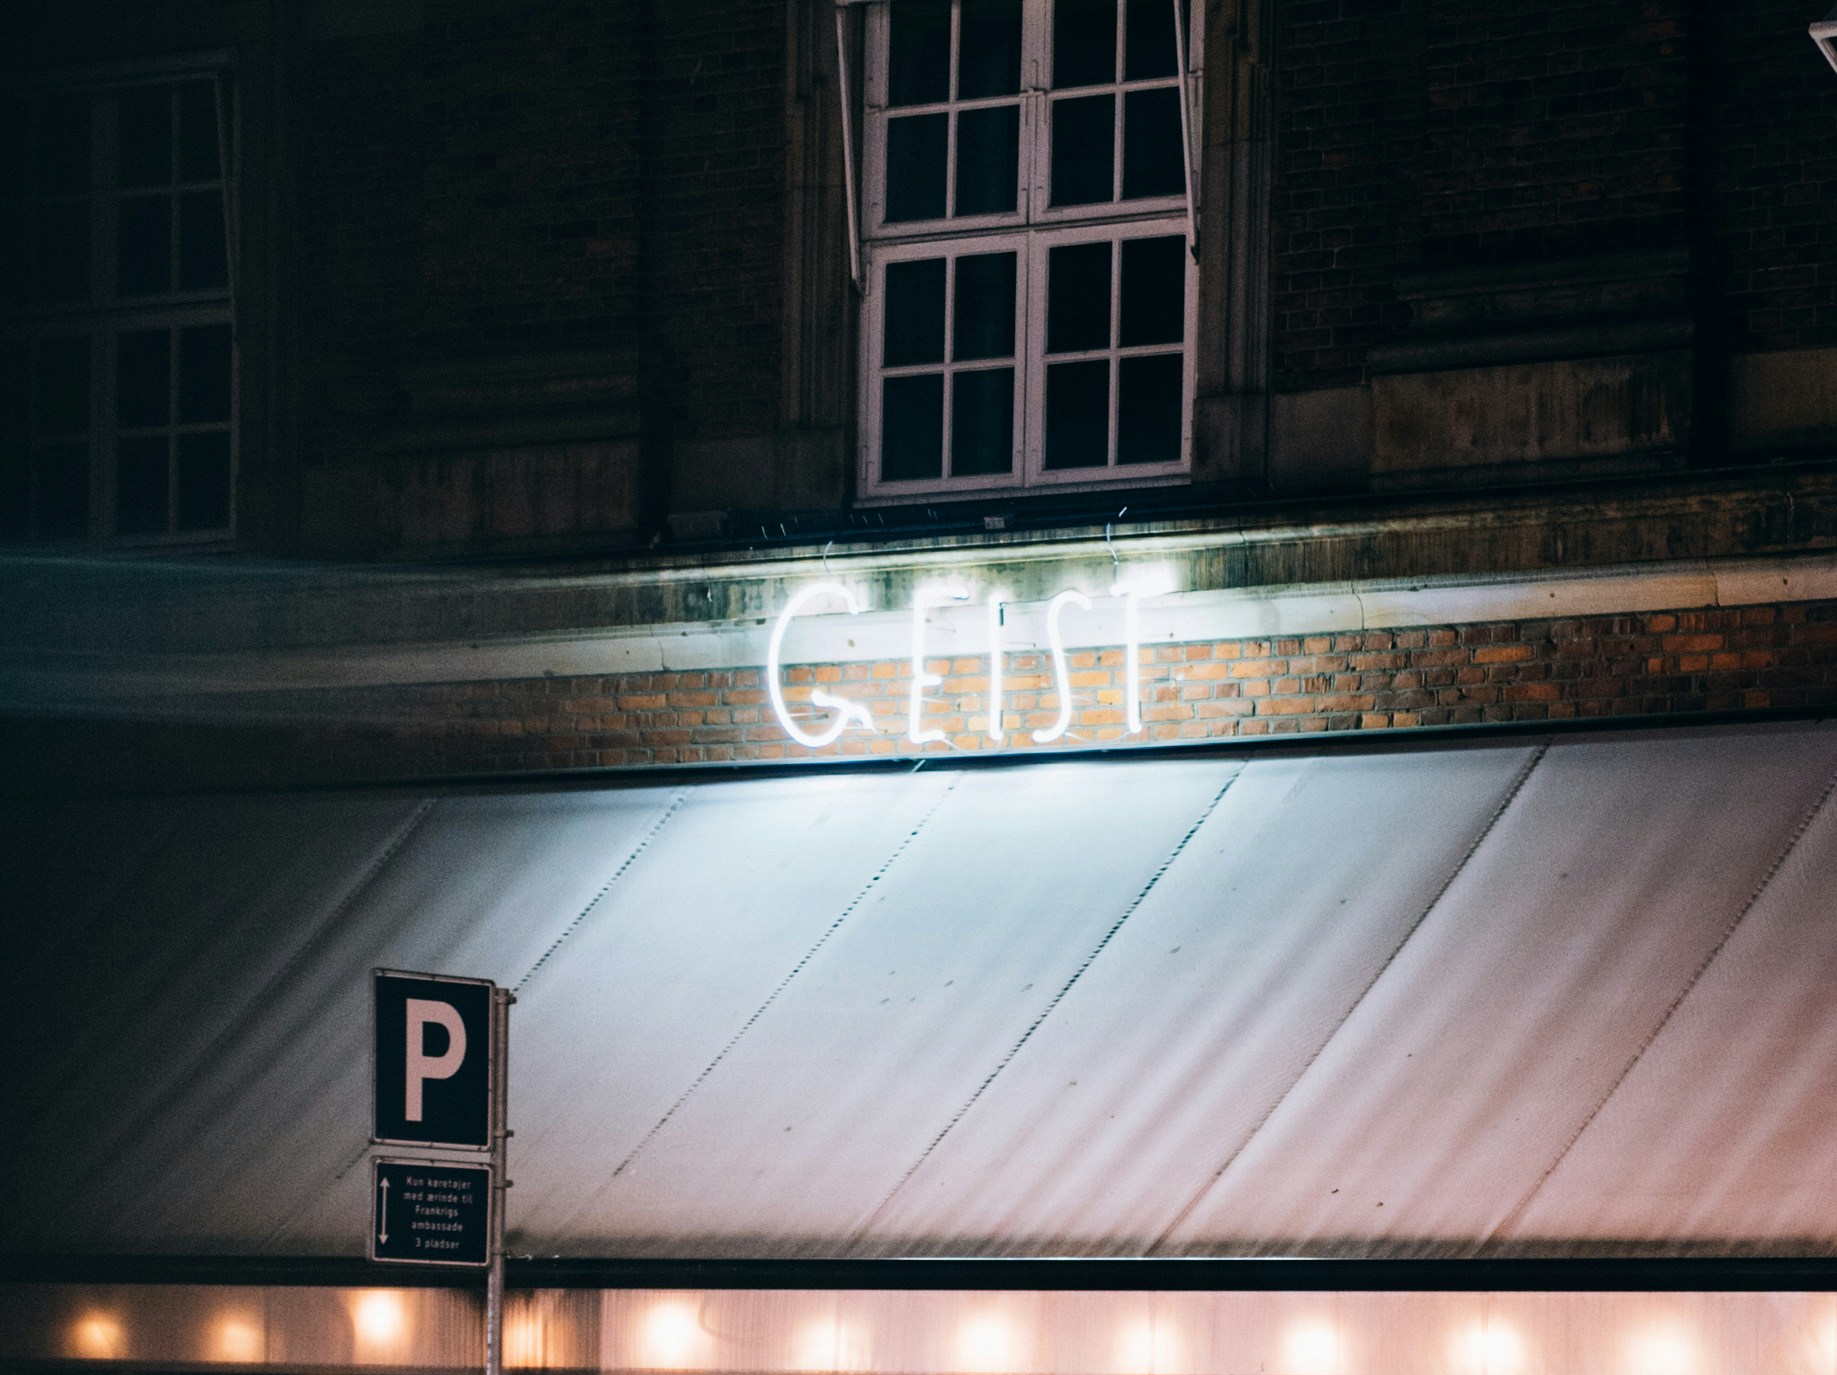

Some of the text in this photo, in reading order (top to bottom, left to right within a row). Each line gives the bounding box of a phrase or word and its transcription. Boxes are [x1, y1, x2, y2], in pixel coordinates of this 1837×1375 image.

[766, 562, 1177, 748] GEIST
[406, 998, 468, 1121] P
[406, 1176, 424, 1186] Kun
[403, 1192, 473, 1204] med ærinde til
[415, 1205, 459, 1219] Frankrigs
[411, 1221, 463, 1232] ambassade
[415, 1237, 460, 1249] 3 pladser
